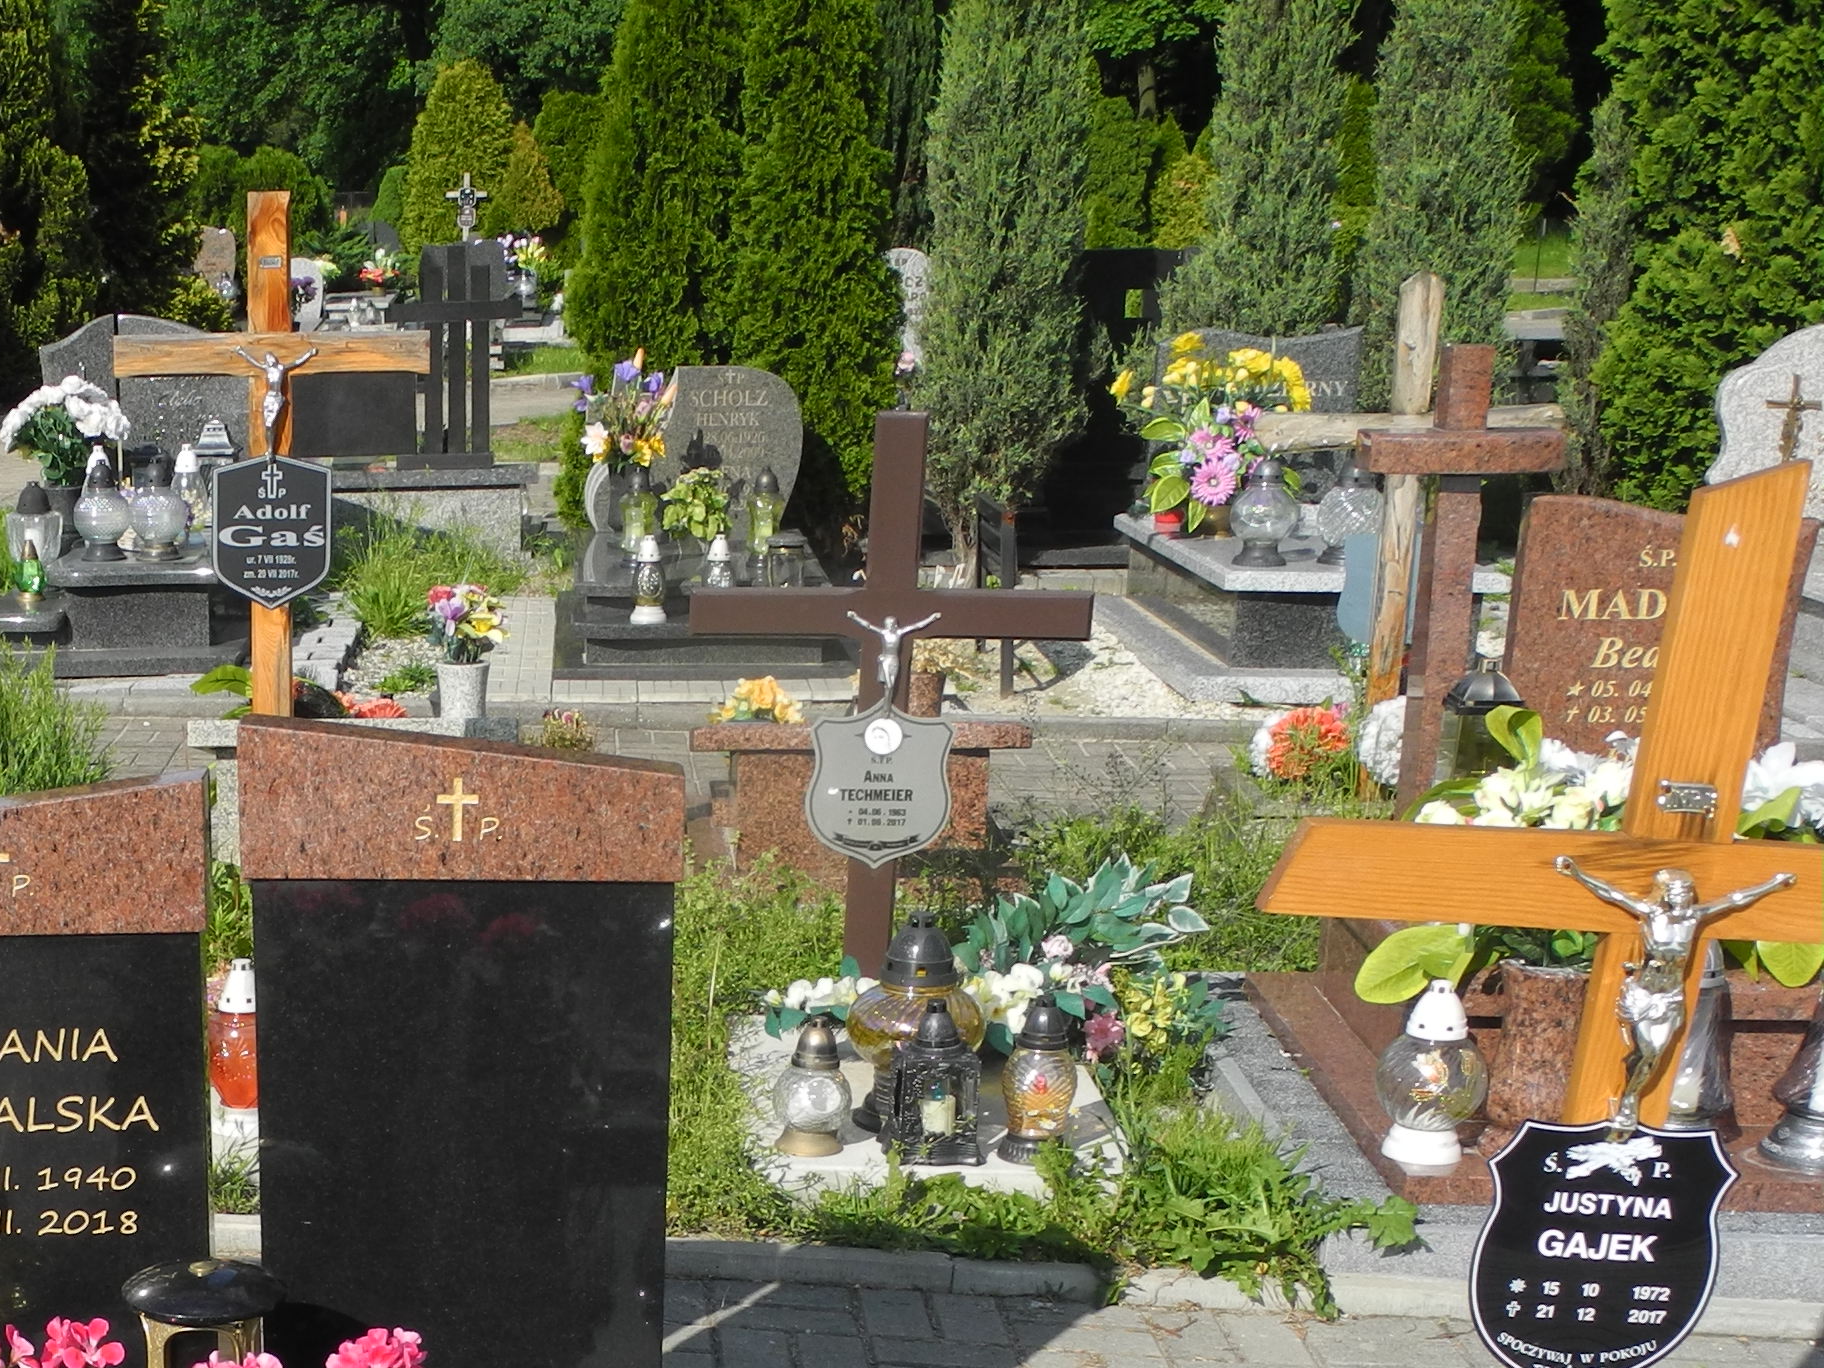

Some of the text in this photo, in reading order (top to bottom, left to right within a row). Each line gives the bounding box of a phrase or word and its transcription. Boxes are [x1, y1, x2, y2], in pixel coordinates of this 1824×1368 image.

[689, 390, 769, 407] SCHOLZ
[696, 412, 759, 426] HENRYK
[278, 488, 286, 498] P
[233, 504, 311, 519] Adolf
[219, 525, 325, 547] Gaś
[1557, 588, 1667, 621] MAD
[1590, 637, 1660, 669] Bea
[840, 788, 913, 801] TECHMEIER
[38, 1165, 137, 1191] 1940
[1653, 1161, 1672, 1179] P.
[1543, 1191, 1672, 1220] JUSTYNA
[39, 1210, 138, 1236] 2018
[1537, 1229, 1658, 1262] GAJEK
[1542, 1281, 1672, 1302] 15 10 1972
[1536, 1304, 1667, 1324] 21 12 2017
[1496, 1331, 1572, 1364] SPOCZYWAJ
[1599, 1339, 1657, 1363] POKOJU
